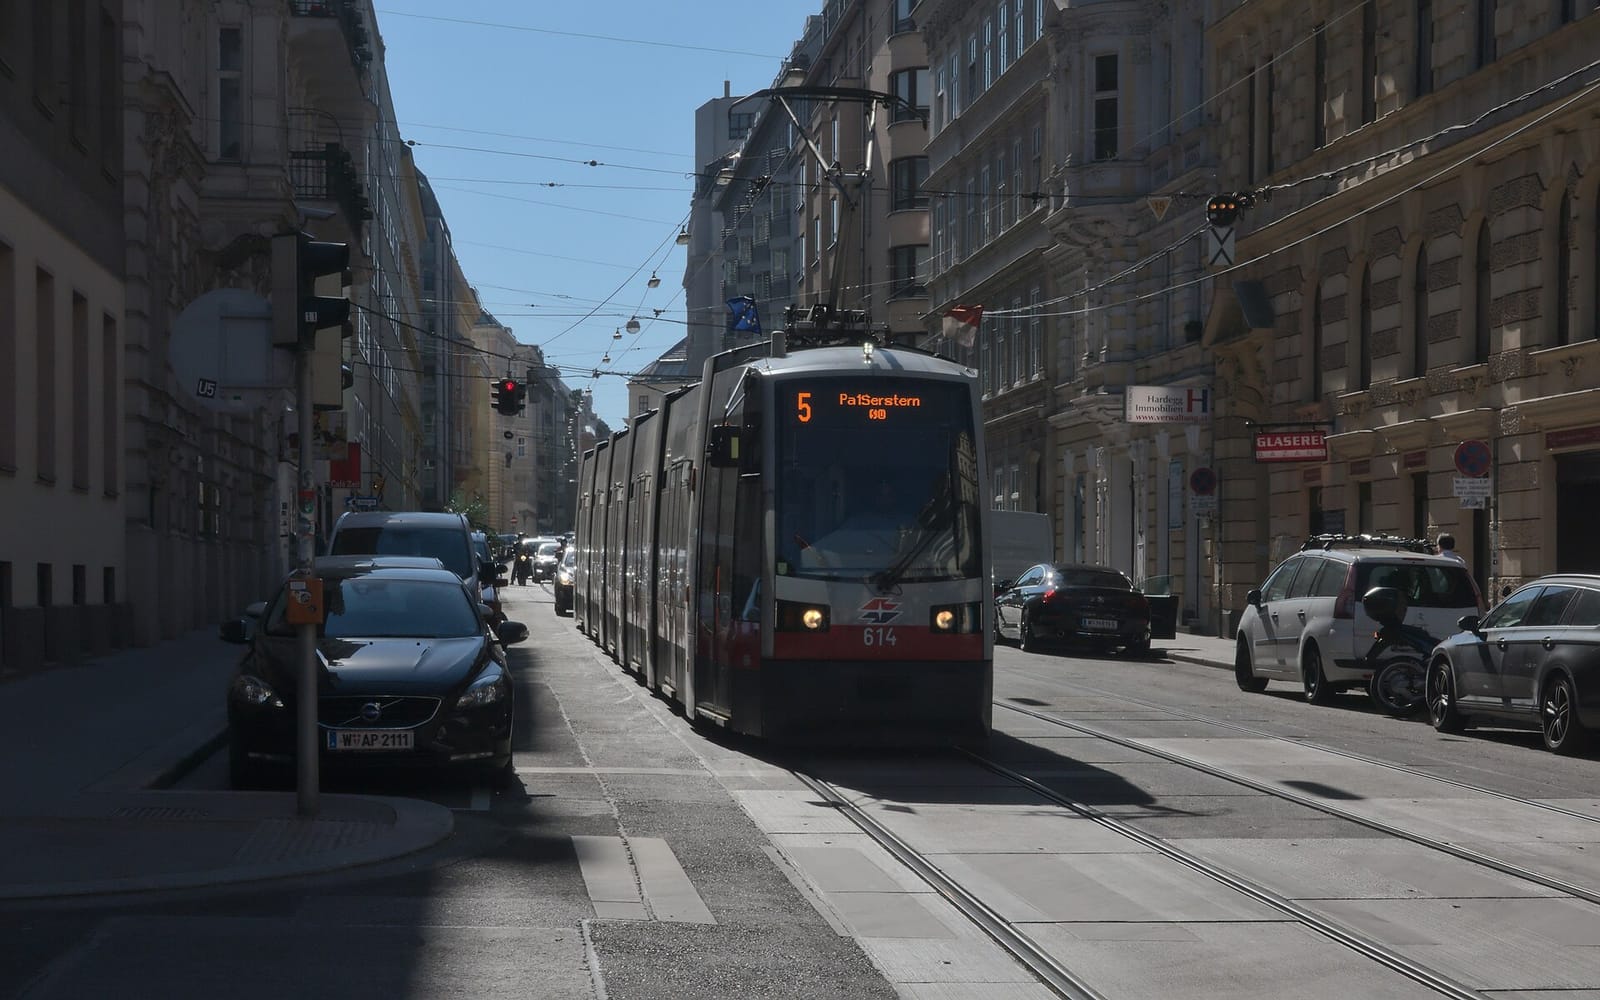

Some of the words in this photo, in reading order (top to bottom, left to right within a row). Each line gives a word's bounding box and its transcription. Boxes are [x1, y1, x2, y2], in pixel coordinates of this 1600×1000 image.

[198, 380, 216, 397] U5
[797, 392, 812, 422] 5
[1147, 395, 1183, 405] Hardegg
[1187, 389, 1207, 412] H
[1135, 404, 1183, 413] Immobilien
[1256, 435, 1325, 448] GLASEREI
[863, 627, 896, 646] 614
[342, 733, 352, 746] W
[361, 733, 379, 746] AP
[382, 733, 408, 746] 2111
